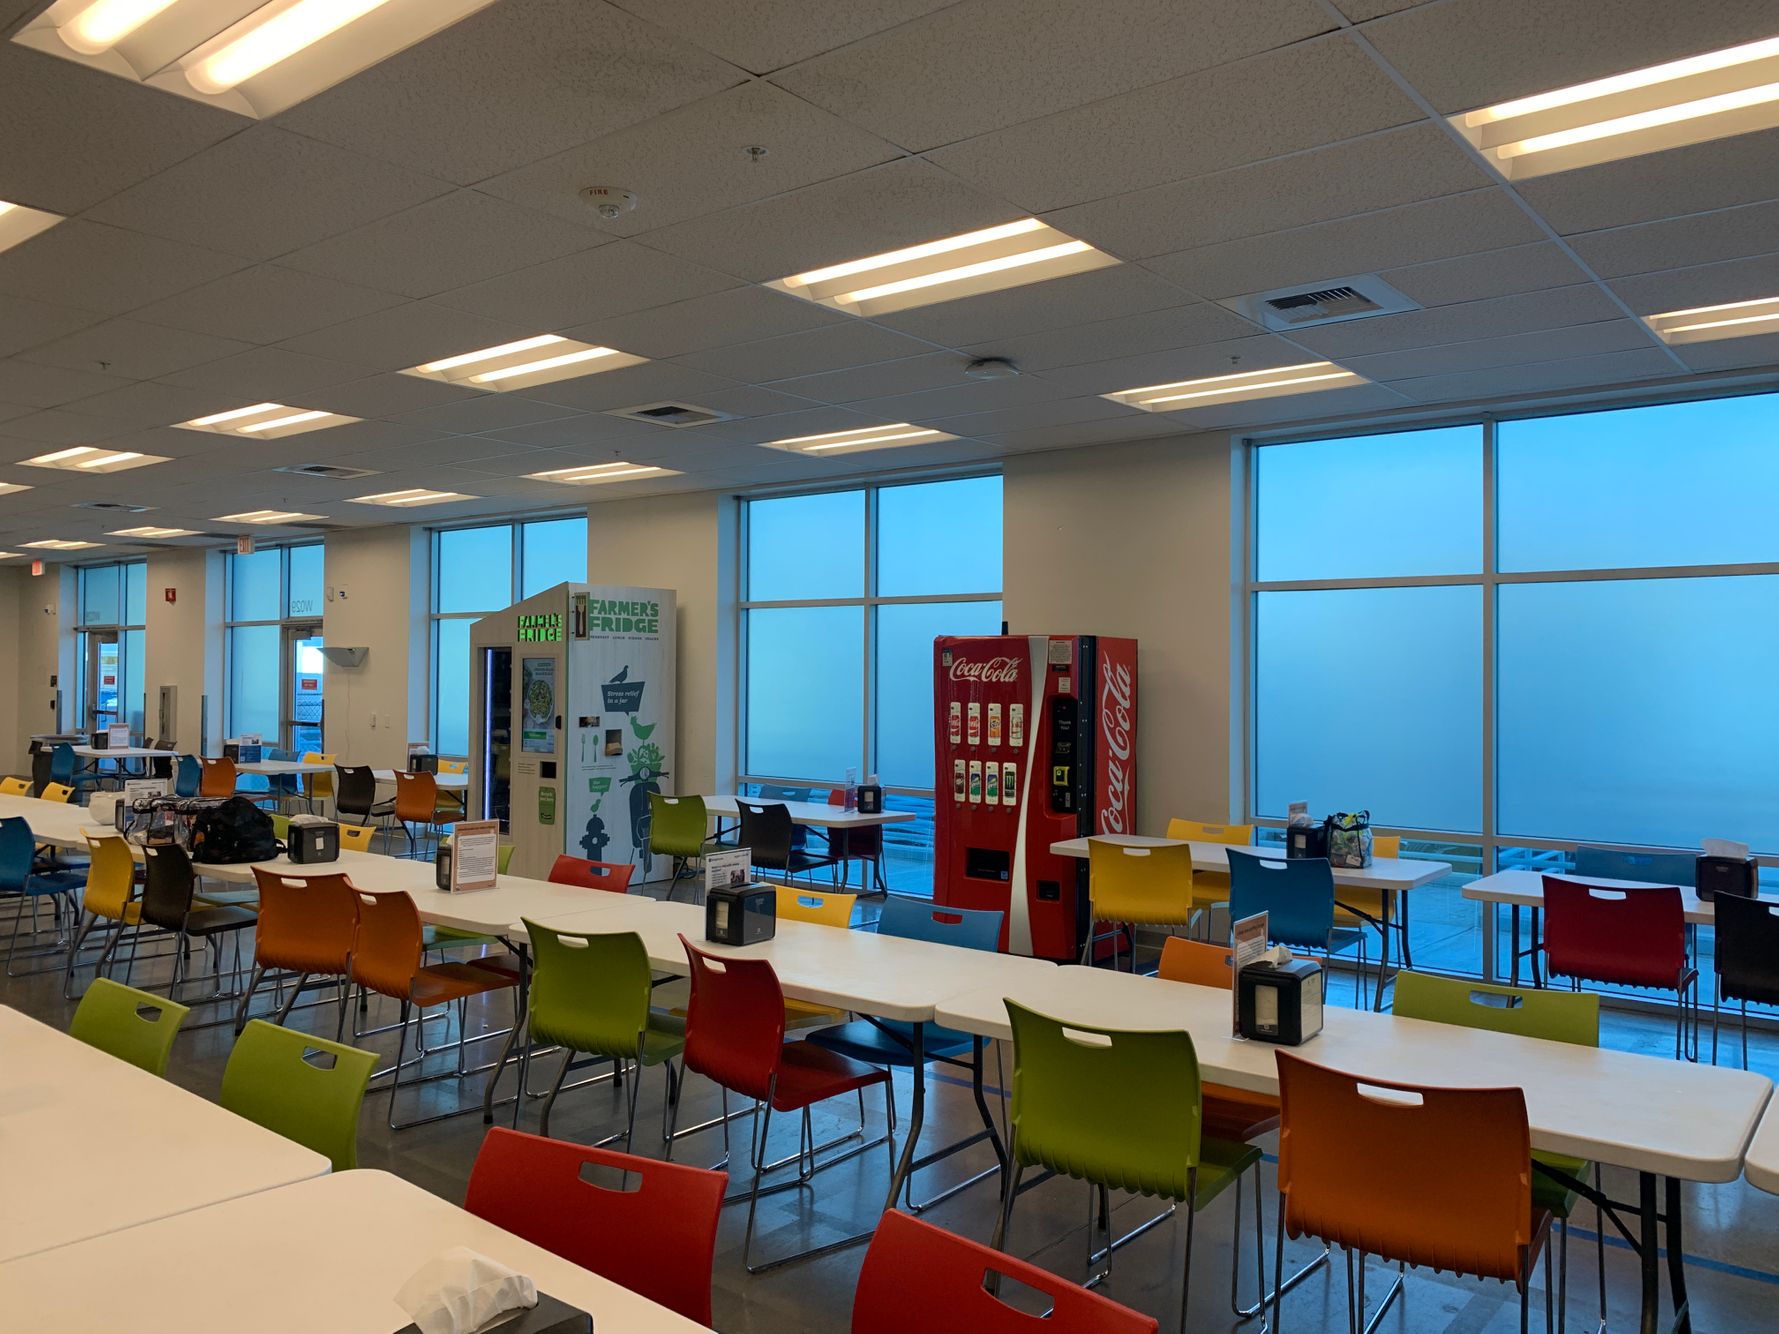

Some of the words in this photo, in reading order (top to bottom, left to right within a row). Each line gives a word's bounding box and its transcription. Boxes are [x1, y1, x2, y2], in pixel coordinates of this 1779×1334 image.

[589, 599, 659, 618] FARMER'S
[518, 613, 562, 628] FARMER'S
[589, 616, 659, 633] FRIDGE
[518, 628, 562, 642] FRIDGE
[950, 657, 1024, 682] Coca-Cola
[624, 690, 640, 698] relief
